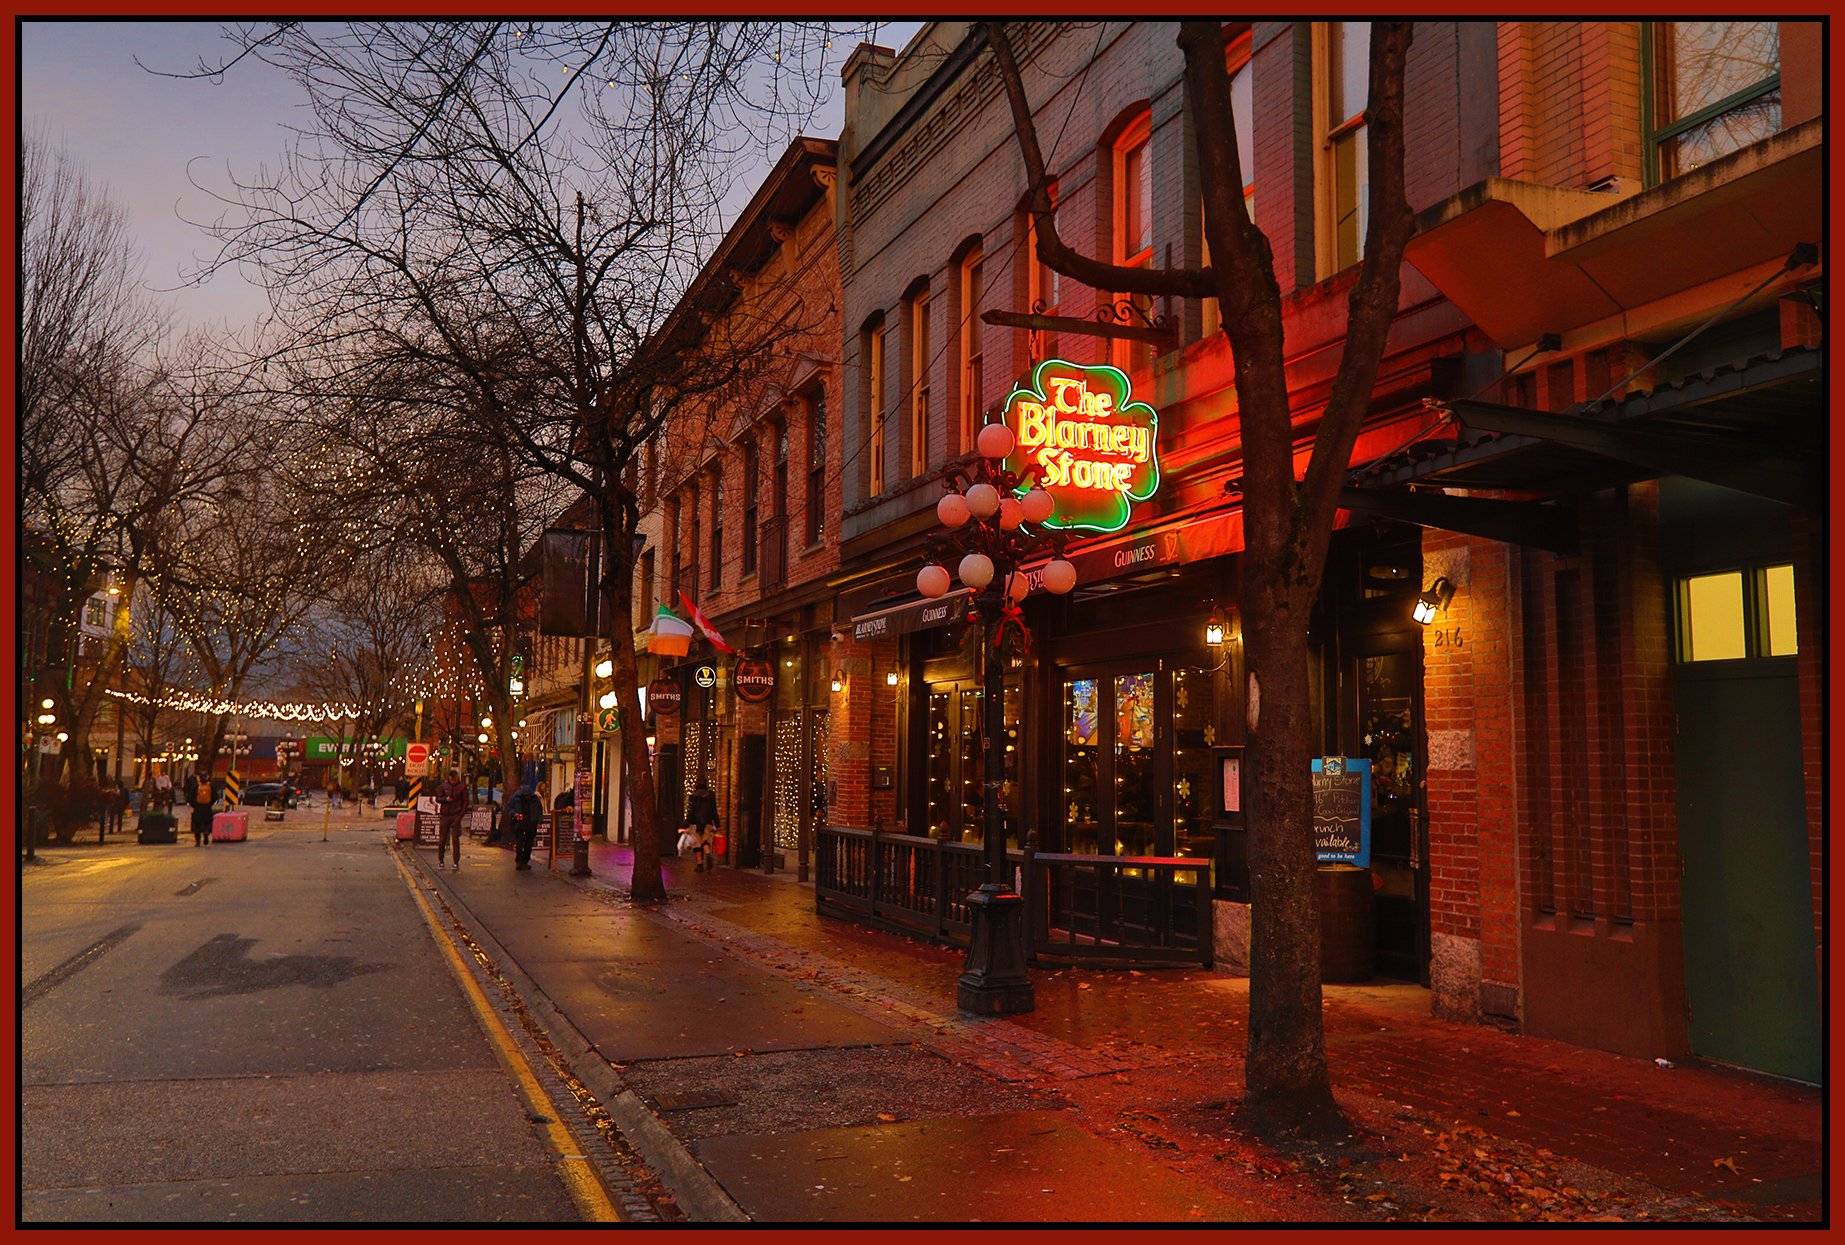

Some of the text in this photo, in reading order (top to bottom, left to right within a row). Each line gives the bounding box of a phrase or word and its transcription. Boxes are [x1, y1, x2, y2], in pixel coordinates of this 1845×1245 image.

[1048, 376, 1113, 417] The
[1018, 400, 1150, 463] Blarney
[1036, 447, 1136, 491] Stone
[1114, 544, 1156, 568] GUINNESS
[922, 605, 949, 623] GUINNESS
[1434, 626, 1464, 648] 216
[736, 675, 774, 686] SMITHS
[650, 693, 681, 701] SMITHS
[1313, 823, 1344, 833] runch
[1315, 834, 1350, 848] vailable
